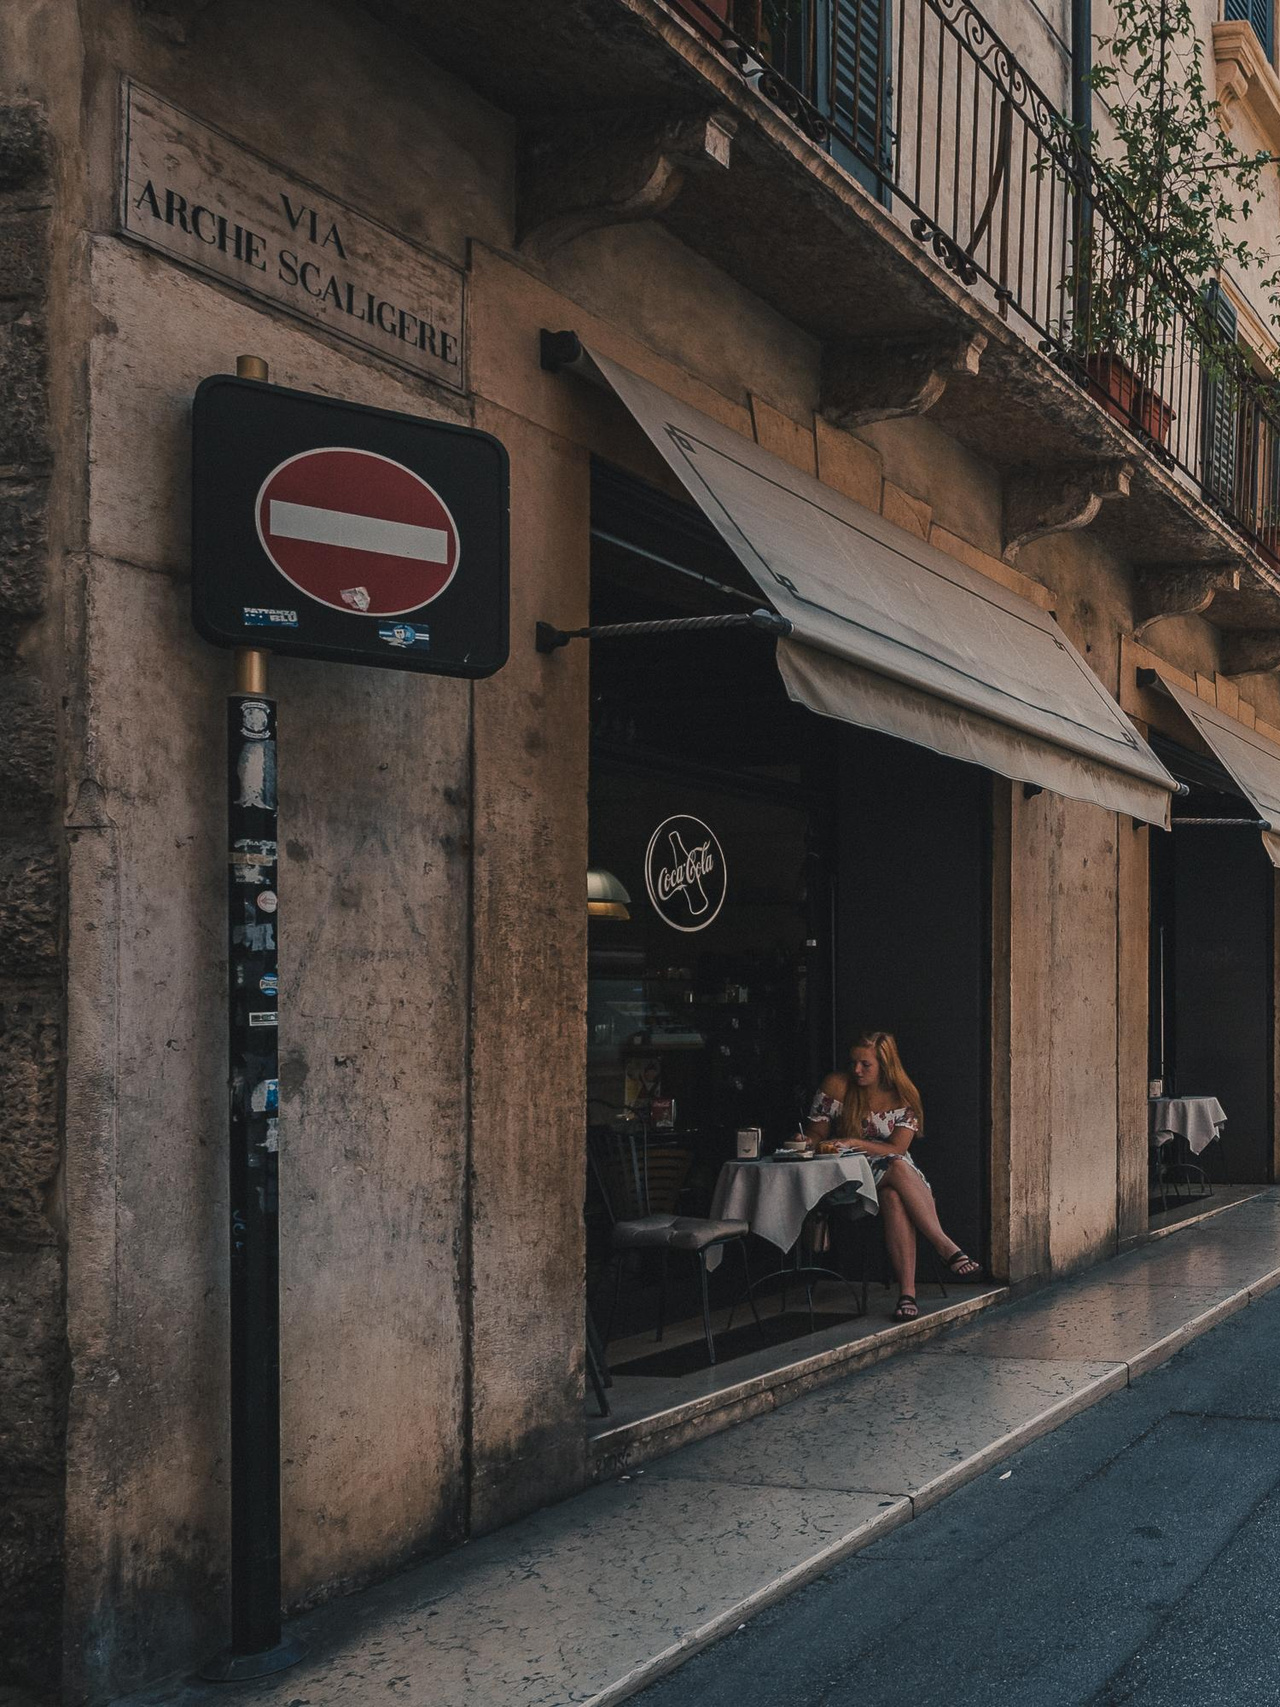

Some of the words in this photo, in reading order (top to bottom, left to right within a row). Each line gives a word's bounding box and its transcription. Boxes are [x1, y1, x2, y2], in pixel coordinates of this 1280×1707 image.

[135, 179, 267, 272] ARCHE
[278, 249, 459, 366] SCALIGERE
[279, 192, 348, 261] VIA
